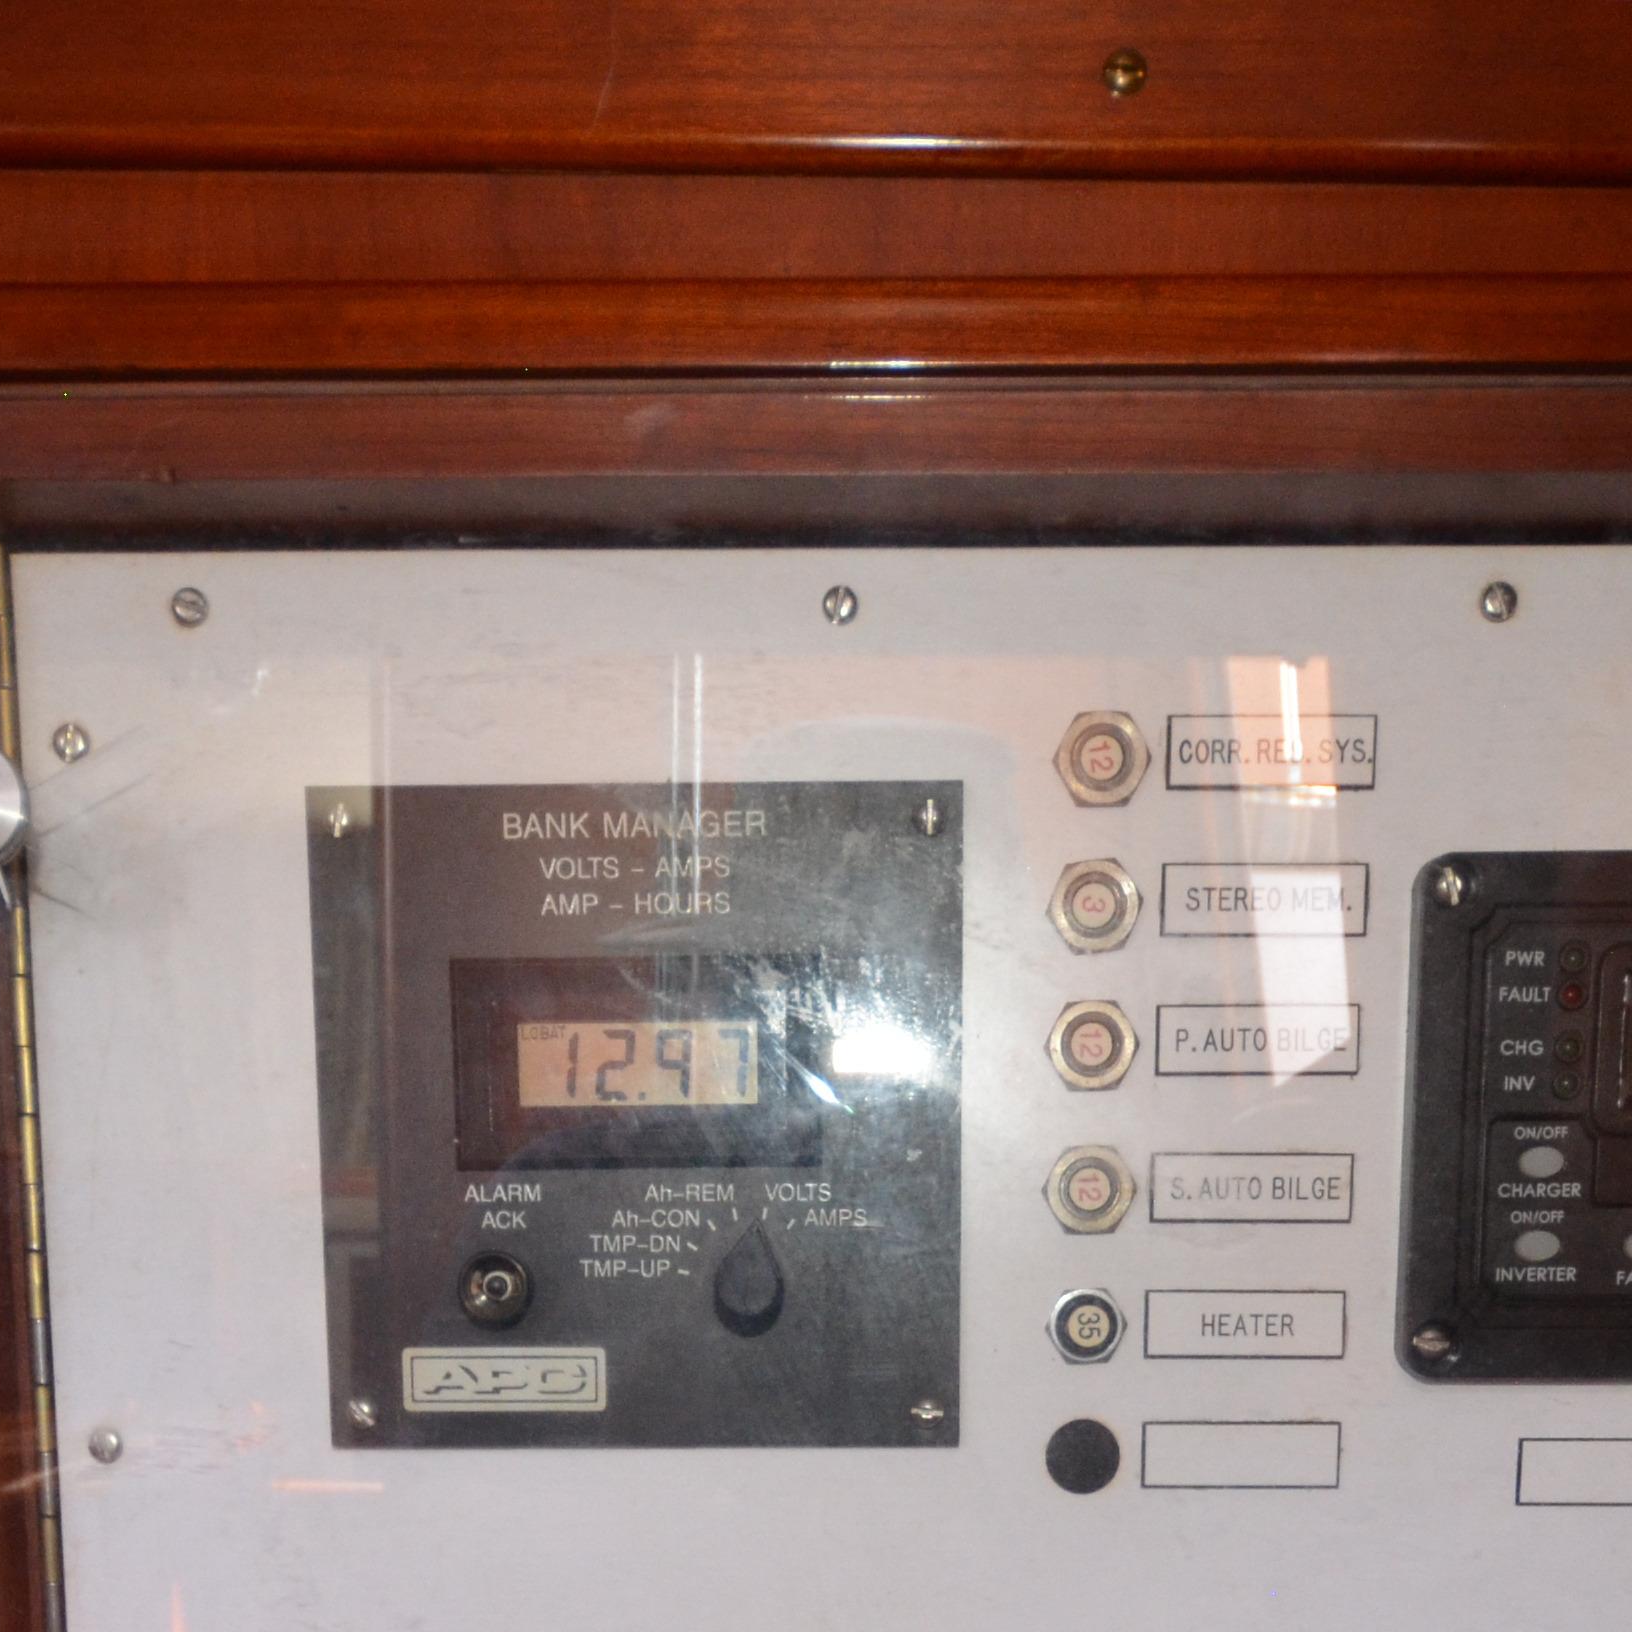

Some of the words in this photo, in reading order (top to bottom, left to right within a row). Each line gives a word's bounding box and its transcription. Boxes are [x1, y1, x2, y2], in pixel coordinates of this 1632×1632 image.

[1089, 744, 1114, 774] 12
[1179, 739, 1250, 764] CORR.
[1319, 739, 1373, 764] SYS.
[502, 813, 590, 839] BANK
[603, 811, 767, 838] MANAGER
[540, 857, 619, 879] VOLTS
[655, 856, 730, 878] AMPS
[541, 896, 599, 916] AMP
[635, 893, 730, 915] HOURS
[1186, 887, 1282, 911] STEREO
[1506, 951, 1545, 966] PWR
[1499, 987, 1551, 1001] FAULT
[1080, 1030, 1103, 1059] 12
[1277, 1029, 1347, 1051] BILGE
[1500, 1040, 1544, 1055] CHG
[566, 1029, 749, 1100] 12.97
[1504, 1076, 1535, 1090] INV
[1514, 1127, 1568, 1139] ON/OFF
[465, 1185, 541, 1201] ALARM
[765, 1184, 832, 1201] VOLTS
[1078, 1175, 1102, 1202] 12
[1171, 1177, 1192, 1200] S.
[1200, 1177, 1262, 1200] AUTO
[1272, 1177, 1340, 1200] BILGE
[1498, 1184, 1581, 1198] CHARGER
[482, 1212, 526, 1229] ACK
[805, 1209, 867, 1226] AMPS
[1510, 1211, 1564, 1224] ON/OFF
[590, 1235, 681, 1252] TMP-DN
[580, 1260, 670, 1278] TMP-UP
[1495, 1267, 1576, 1282] INVERTER
[1077, 1312, 1101, 1339] 35
[1201, 1314, 1294, 1337] HEATER
